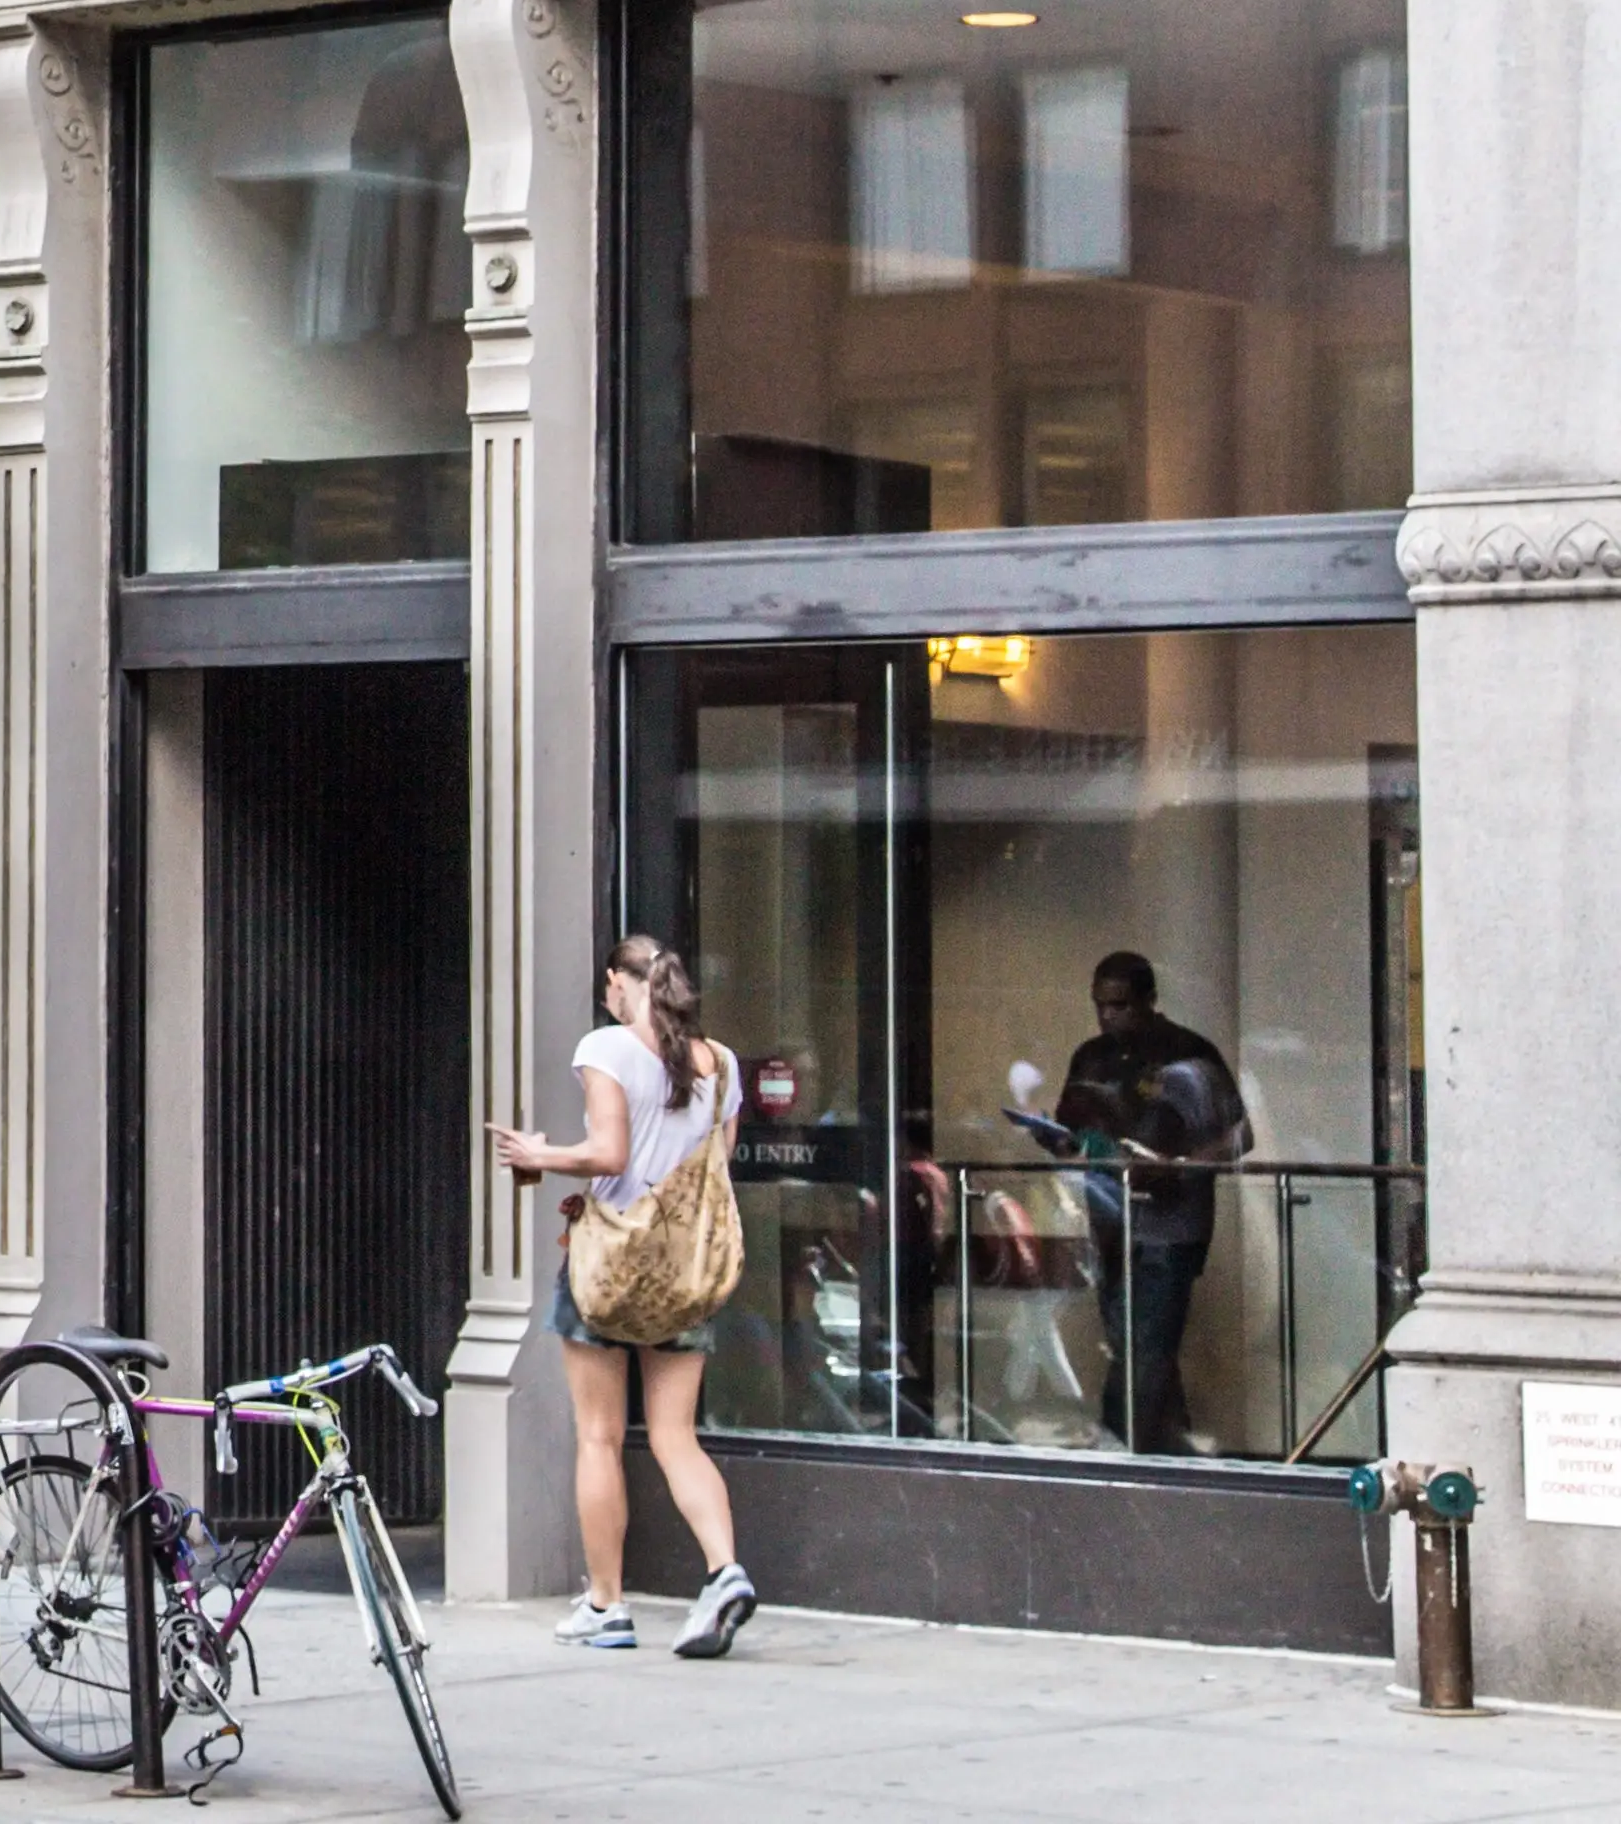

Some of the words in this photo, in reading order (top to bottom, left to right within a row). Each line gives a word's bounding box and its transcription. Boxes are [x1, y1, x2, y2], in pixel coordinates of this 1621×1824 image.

[755, 1142, 819, 1165] ENTRY
[1560, 1412, 1599, 1427] WEST
[1558, 1458, 1614, 1475] SYSTEM
